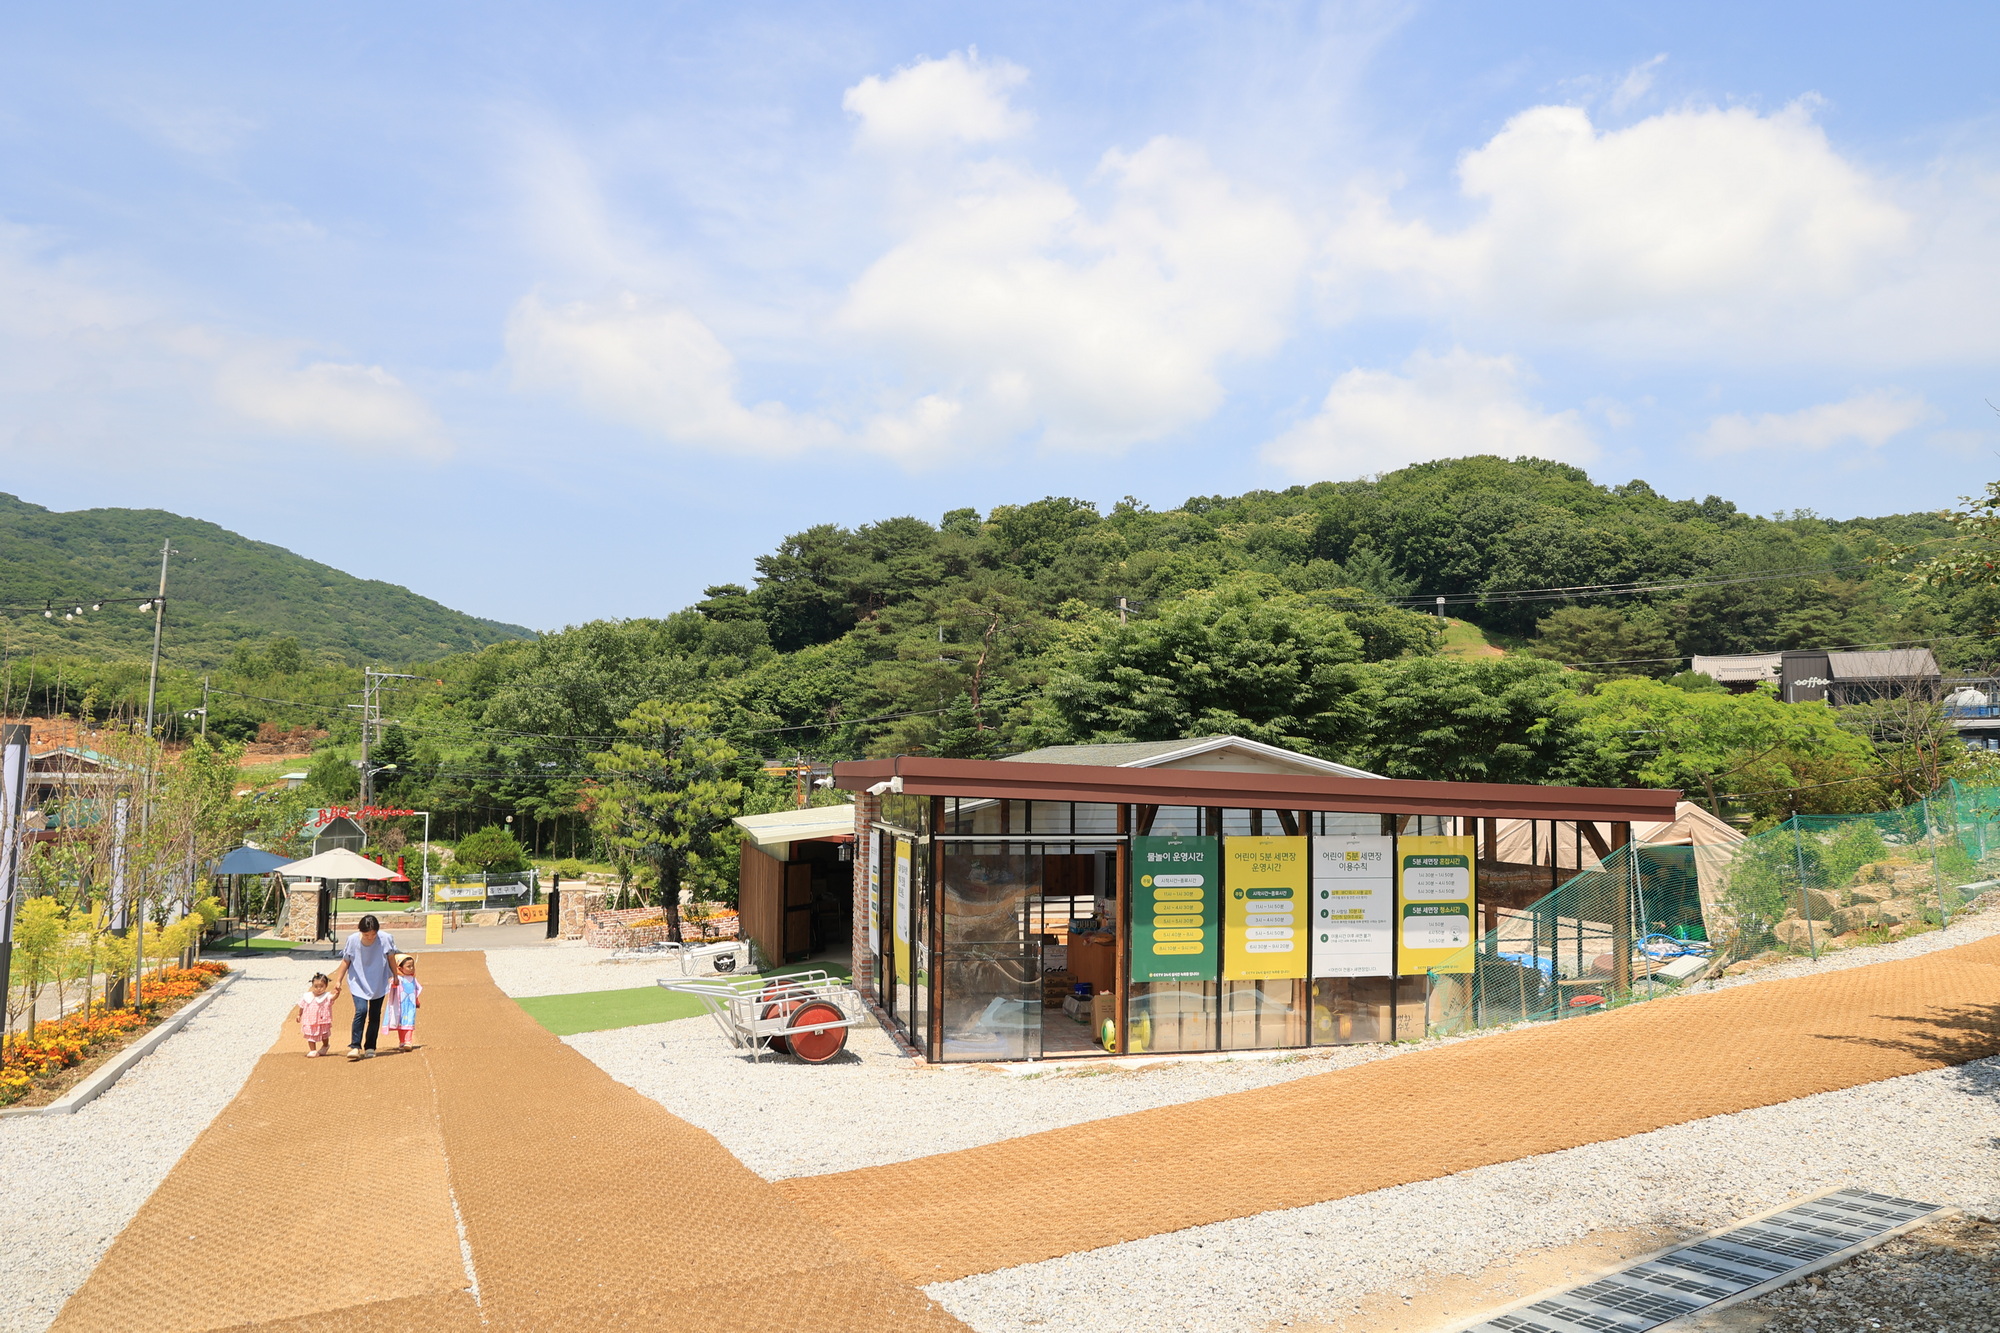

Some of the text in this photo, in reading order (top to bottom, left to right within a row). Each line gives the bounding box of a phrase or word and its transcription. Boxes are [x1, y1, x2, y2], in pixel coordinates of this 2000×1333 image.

[1794, 676, 1830, 688] coffee
[315, 806, 350, 828] BBQ
[1147, 852, 1204, 862] 물놀이 운영시간
[1235, 853, 1296, 861] 어린이 5분 세면장
[1323, 852, 1382, 860] 어린이 5분 세면장
[1252, 863, 1281, 872] 운영시간
[1339, 863, 1368, 871] 이용수칙
